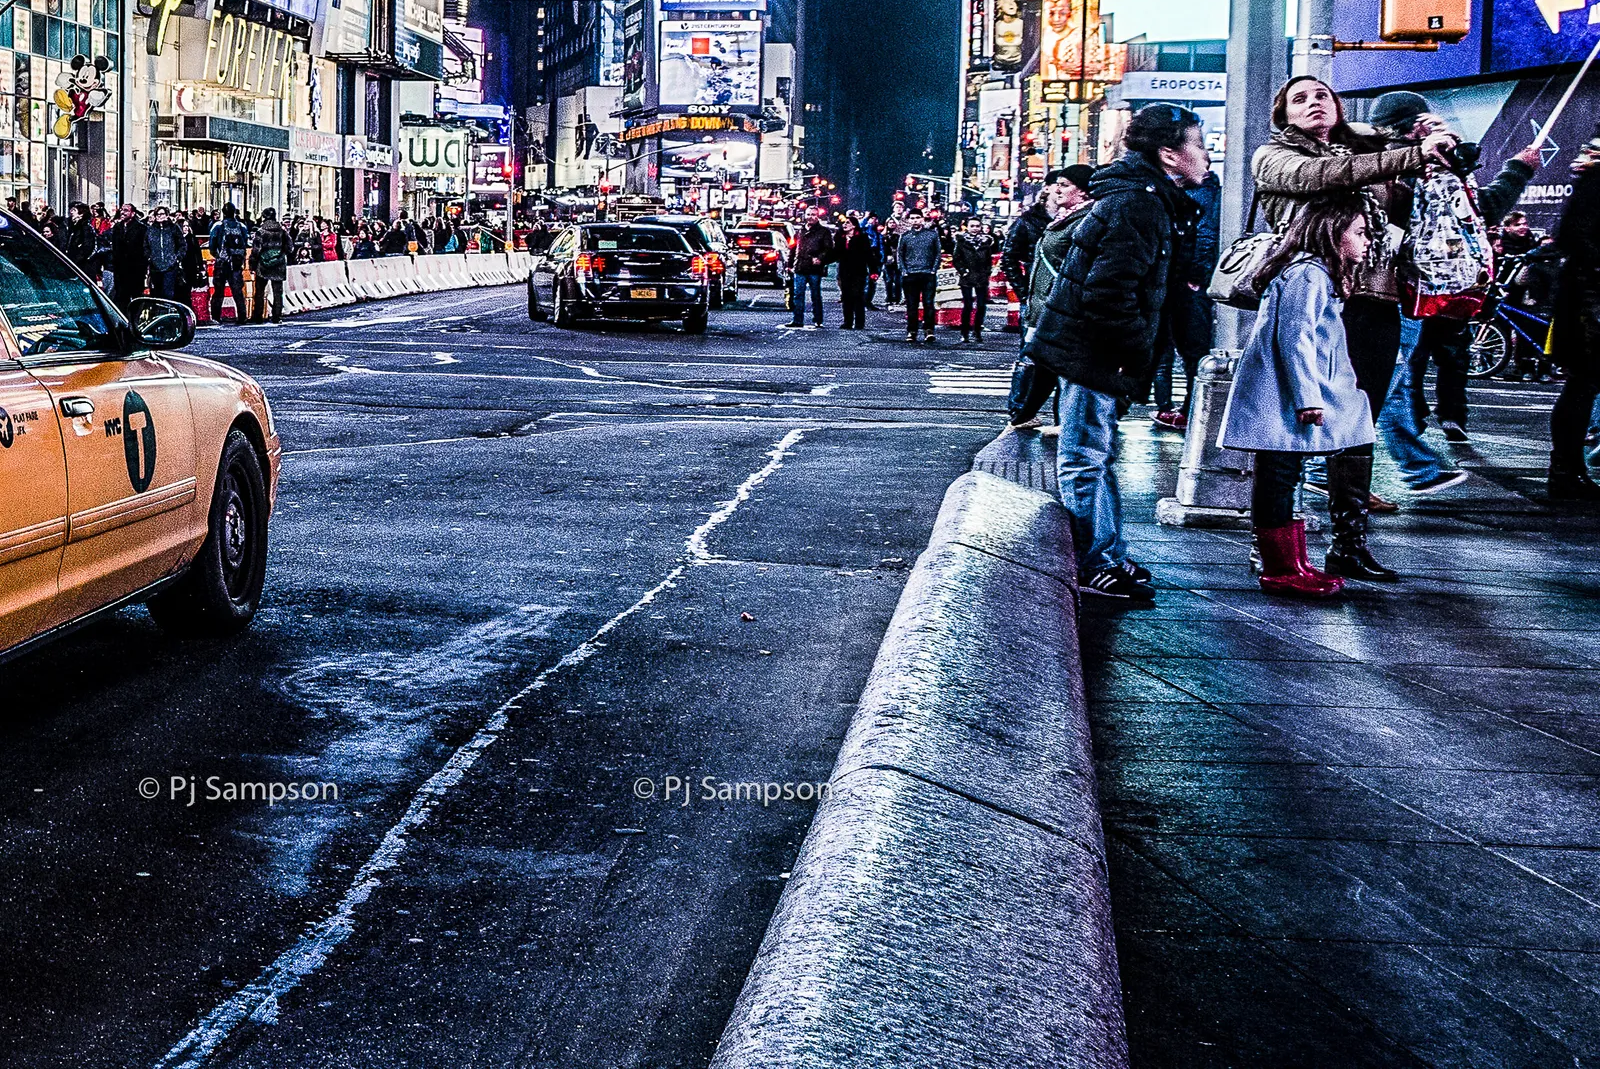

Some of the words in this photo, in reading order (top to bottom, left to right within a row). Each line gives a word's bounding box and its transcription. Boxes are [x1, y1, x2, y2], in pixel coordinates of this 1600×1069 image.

[203, 9, 295, 99] FOREVER
[687, 105, 732, 115] SONY
[229, 145, 263, 173] FOREVER
[12, 413, 26, 425] FLAT
[25, 411, 39, 423] FARE
[15, 426, 27, 438] JFK
[103, 418, 123, 438] NYC
[129, 410, 149, 482] T
